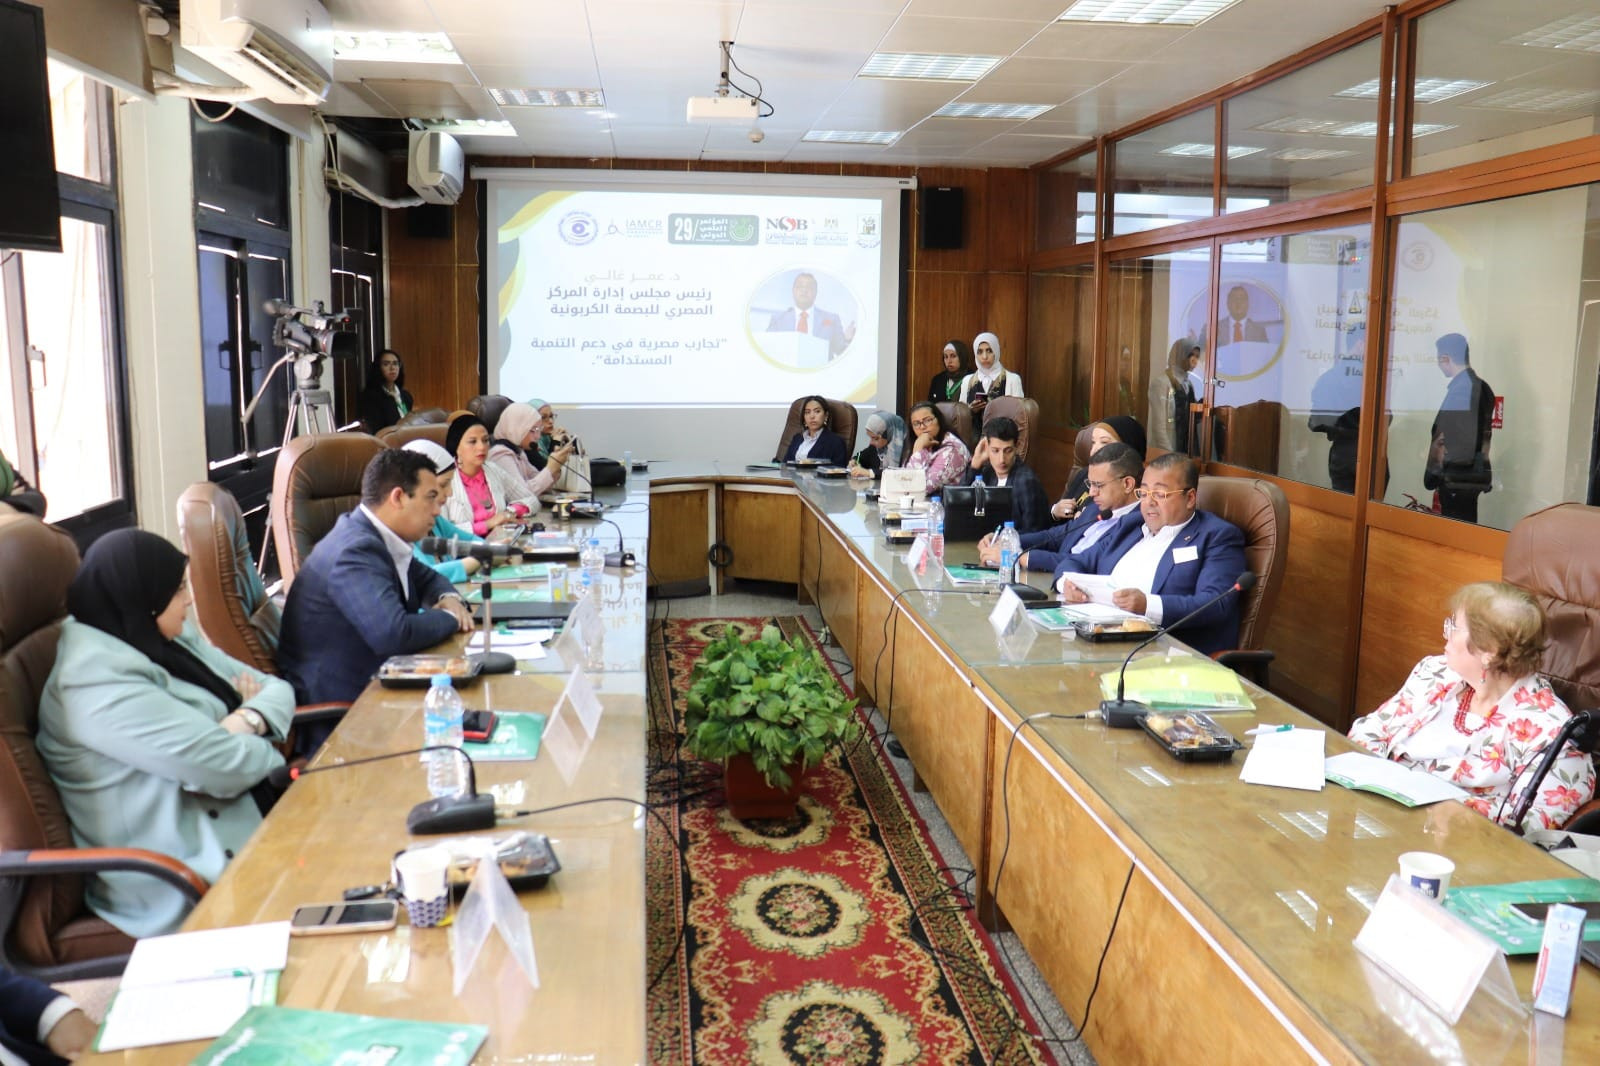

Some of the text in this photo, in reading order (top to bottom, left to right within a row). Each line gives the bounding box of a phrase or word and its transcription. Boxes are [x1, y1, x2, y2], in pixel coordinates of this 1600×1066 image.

[546, 286, 712, 301] رئيس مجلس إدارة المركز
[550, 302, 713, 320] المصري للبصمة الكربونية
[531, 337, 576, 352] التنمية
[581, 338, 607, 352] دعم
[611, 338, 634, 353] في
[639, 338, 680, 352] مصرية
